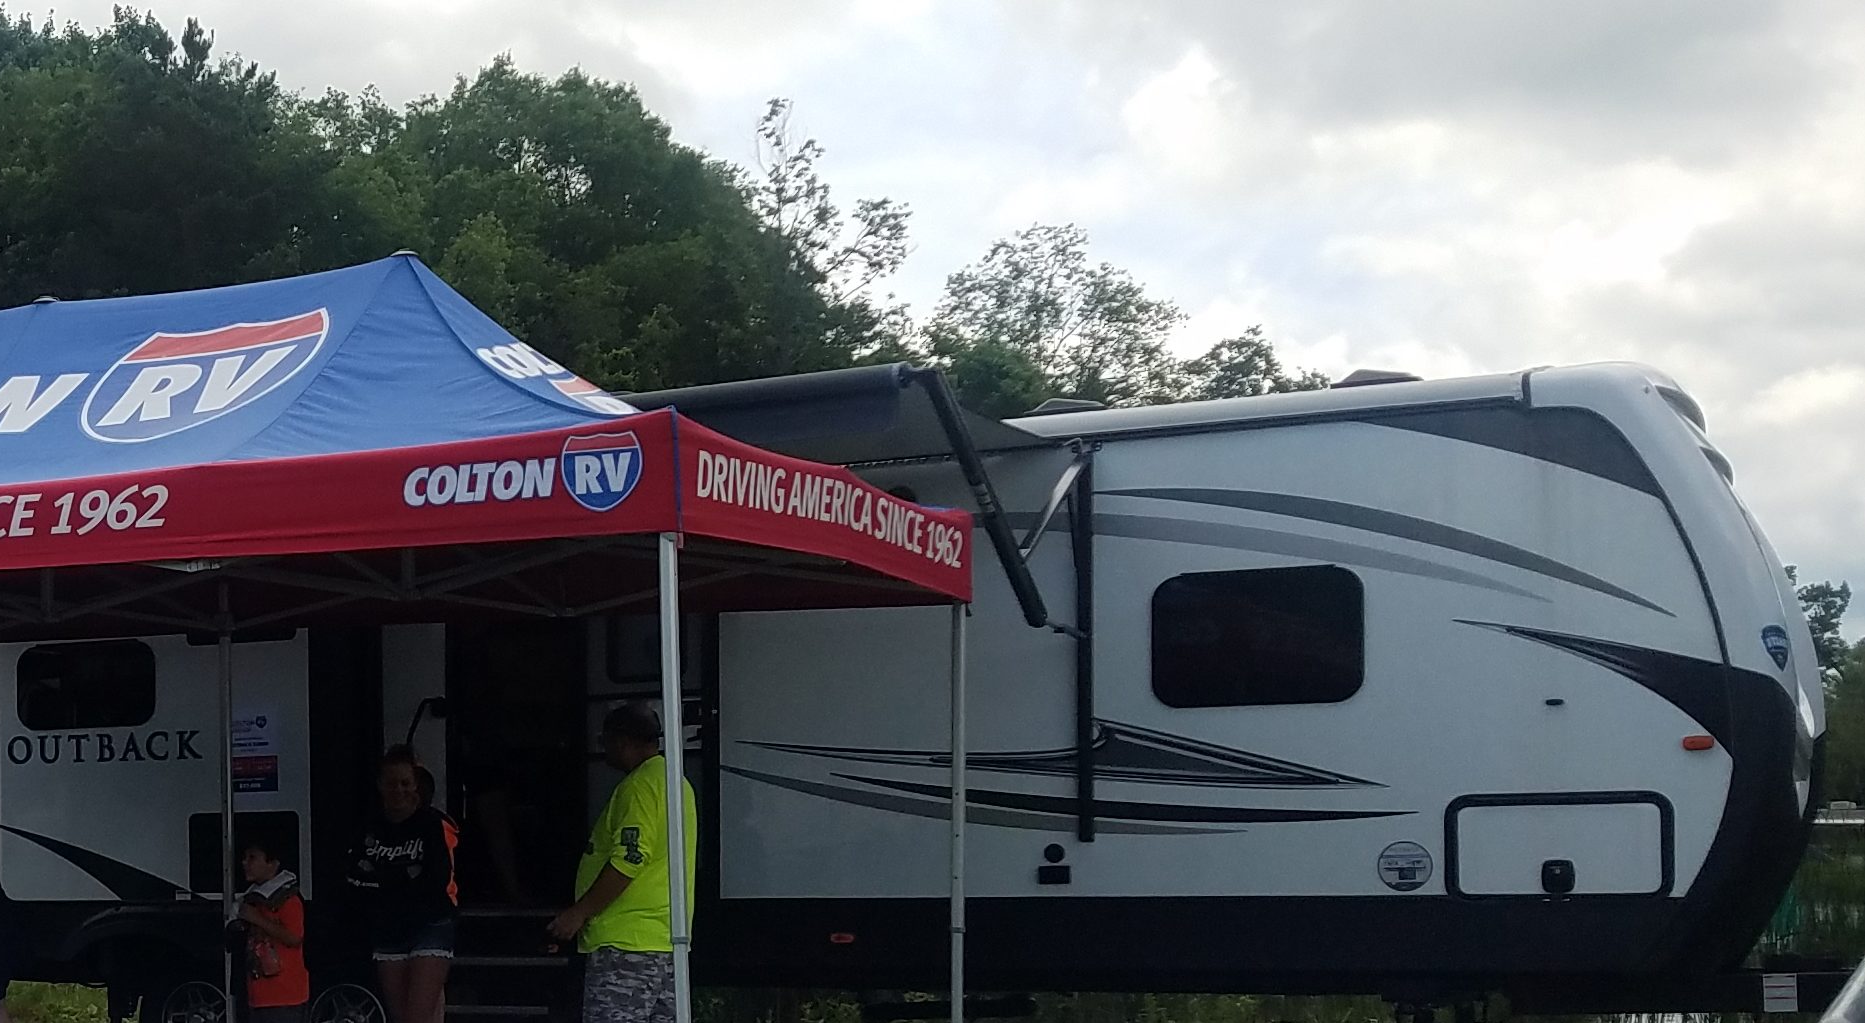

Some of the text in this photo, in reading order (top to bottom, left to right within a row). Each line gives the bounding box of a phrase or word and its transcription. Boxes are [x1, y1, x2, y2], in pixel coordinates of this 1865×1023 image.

[96, 344, 297, 426] RV
[477, 342, 566, 379] COL
[403, 451, 633, 506] COLTON RV
[49, 484, 169, 536] 1962
[697, 450, 963, 569] DRIVING AMERICA SINCE 1962
[7, 730, 203, 765] OUTBACK
